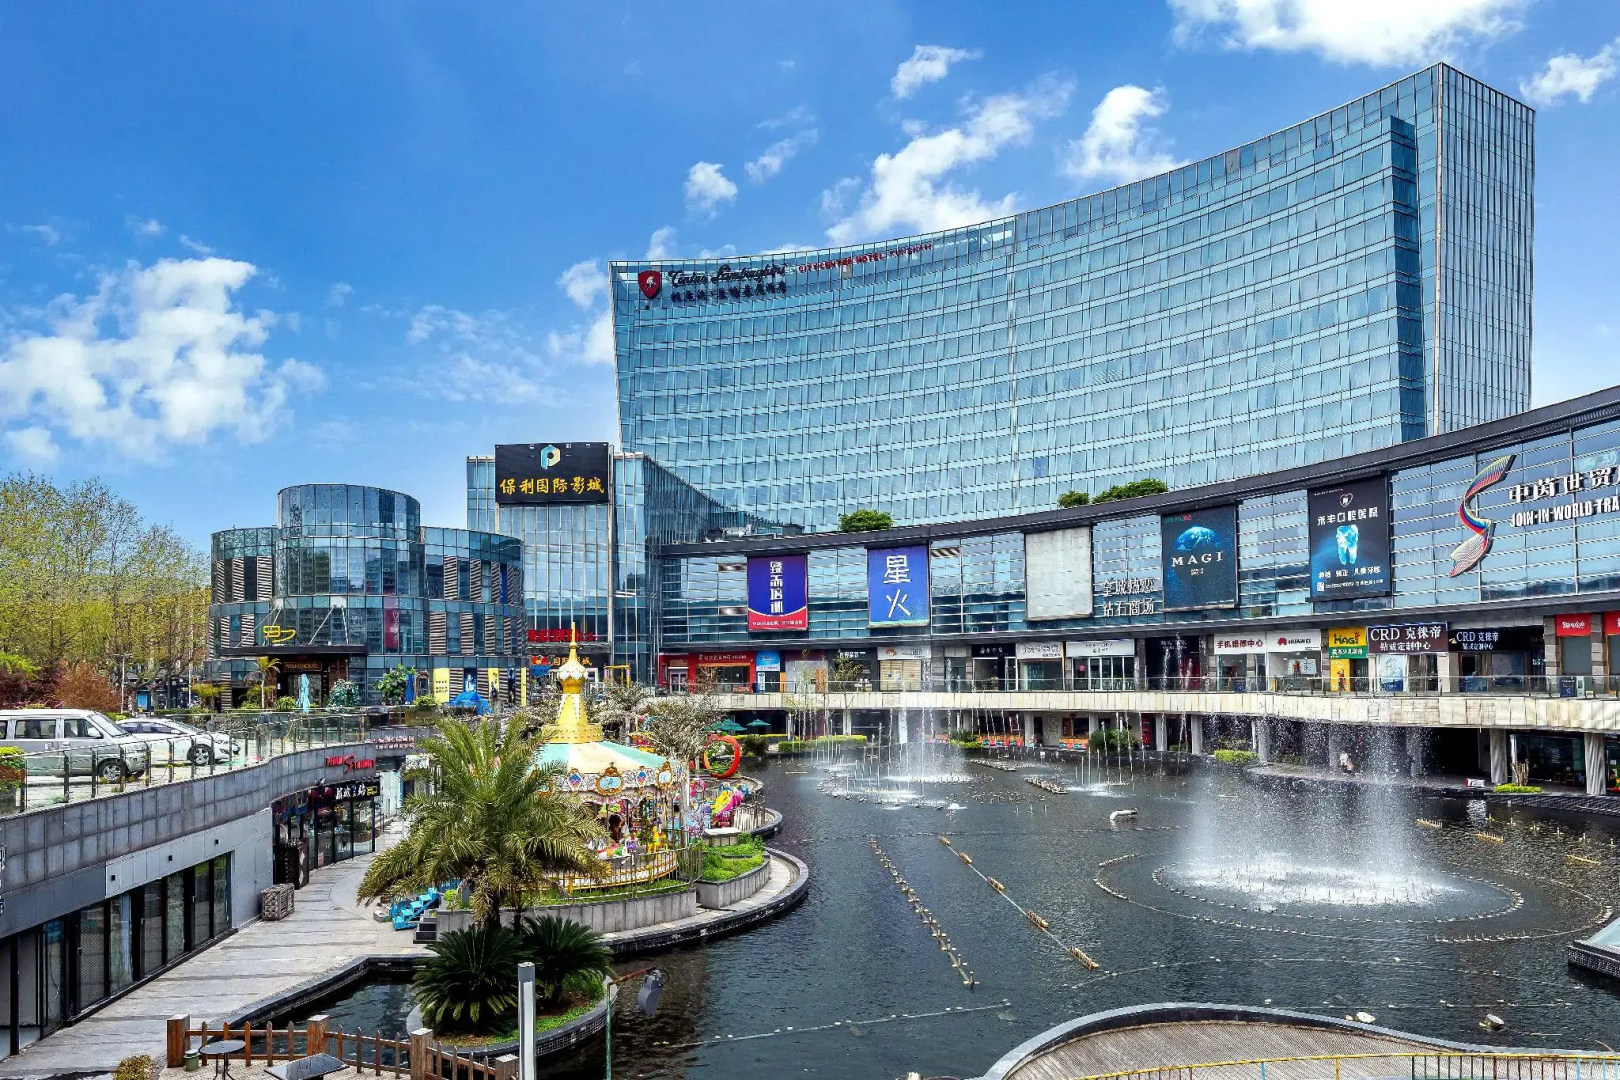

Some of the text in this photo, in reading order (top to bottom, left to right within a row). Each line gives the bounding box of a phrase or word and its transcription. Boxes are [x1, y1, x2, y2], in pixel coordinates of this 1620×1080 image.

[499, 476, 605, 496] 保利国际影城
[1508, 464, 1620, 503] 中茵世贸
[1510, 510, 1534, 528] JOIN
[1553, 500, 1593, 521] WORLD
[1171, 550, 1224, 567] MAGI
[883, 554, 911, 619] 星火
[1103, 576, 1154, 597] 全城热恋
[1103, 597, 1154, 617] 钻石商场
[1370, 628, 1400, 641] CRD
[1456, 631, 1476, 642] CRD
